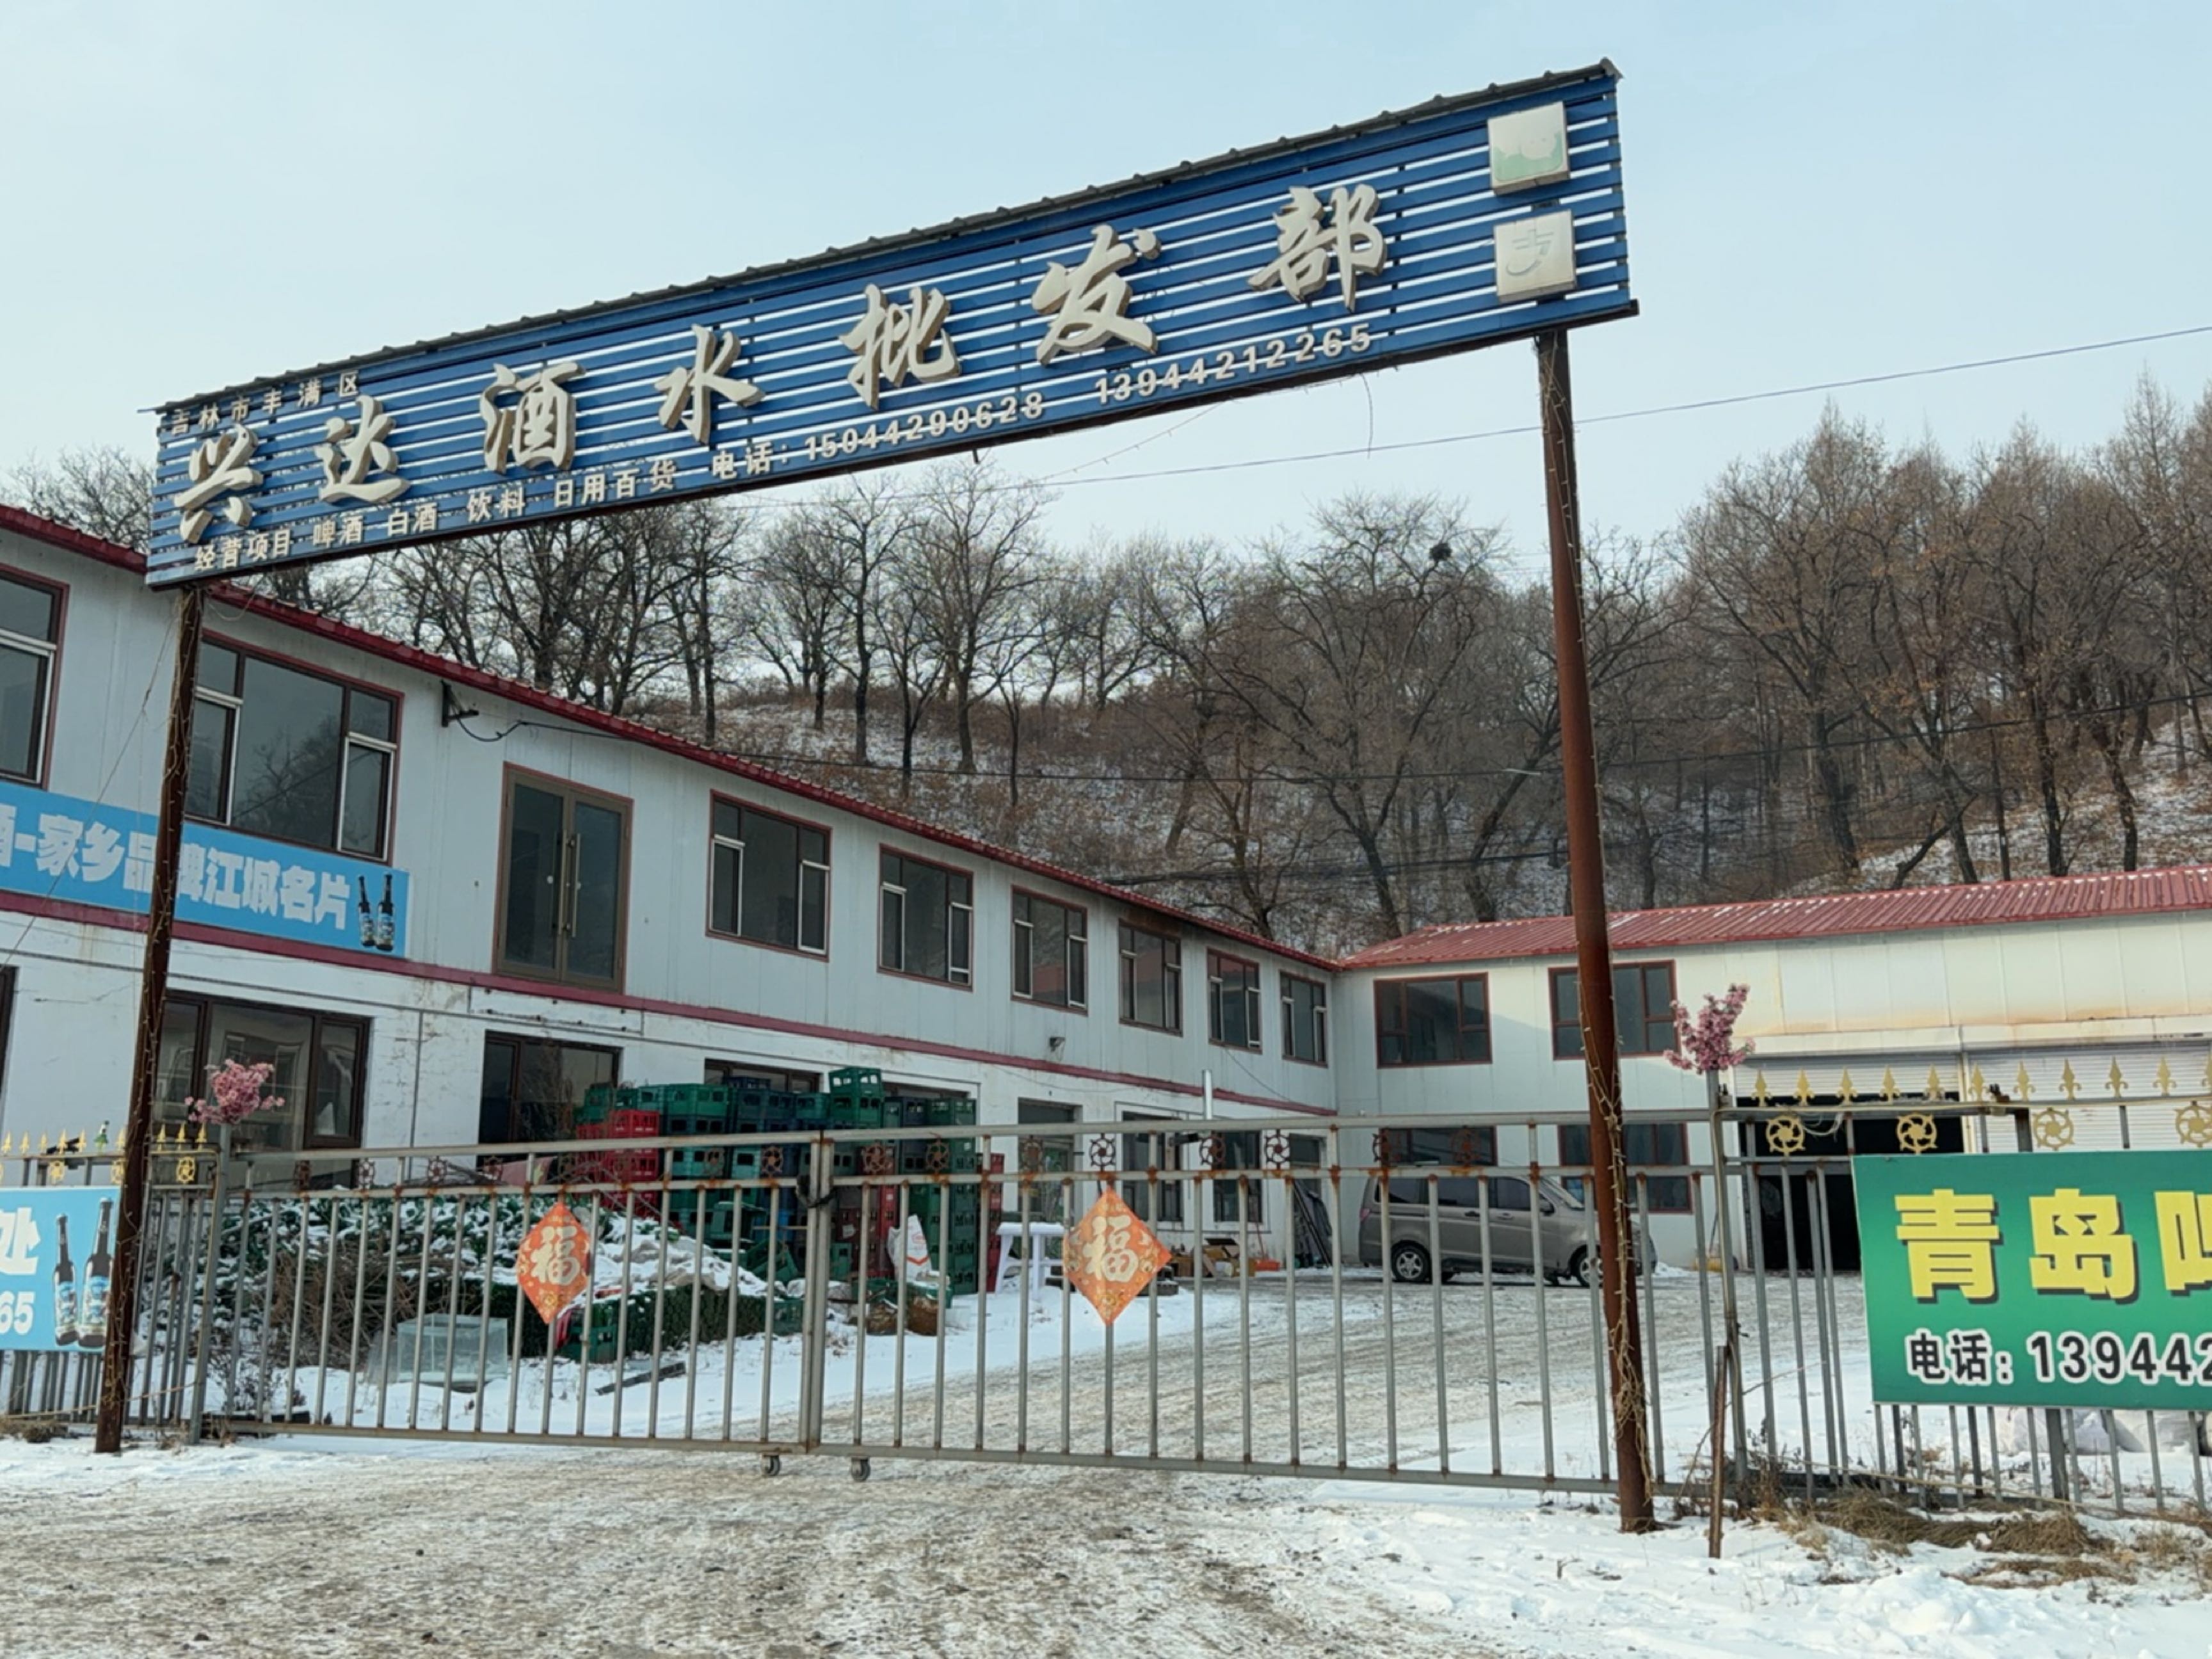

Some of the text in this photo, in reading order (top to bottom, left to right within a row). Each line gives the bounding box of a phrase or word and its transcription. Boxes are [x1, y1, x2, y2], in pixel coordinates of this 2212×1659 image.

[173, 183, 1389, 544] 兴达酒水批发部
[172, 370, 360, 437] 吉林市丰满区
[194, 528, 292, 572] 经营项目
[312, 513, 364, 549] 啤酒
[387, 501, 438, 536] 白酒
[467, 486, 526, 524] 饮料
[553, 460, 678, 507] 日用百货
[1094, 323, 1372, 405] 13944212265
[531, 1225, 581, 1286] 福
[1082, 1215, 1139, 1283] 福
